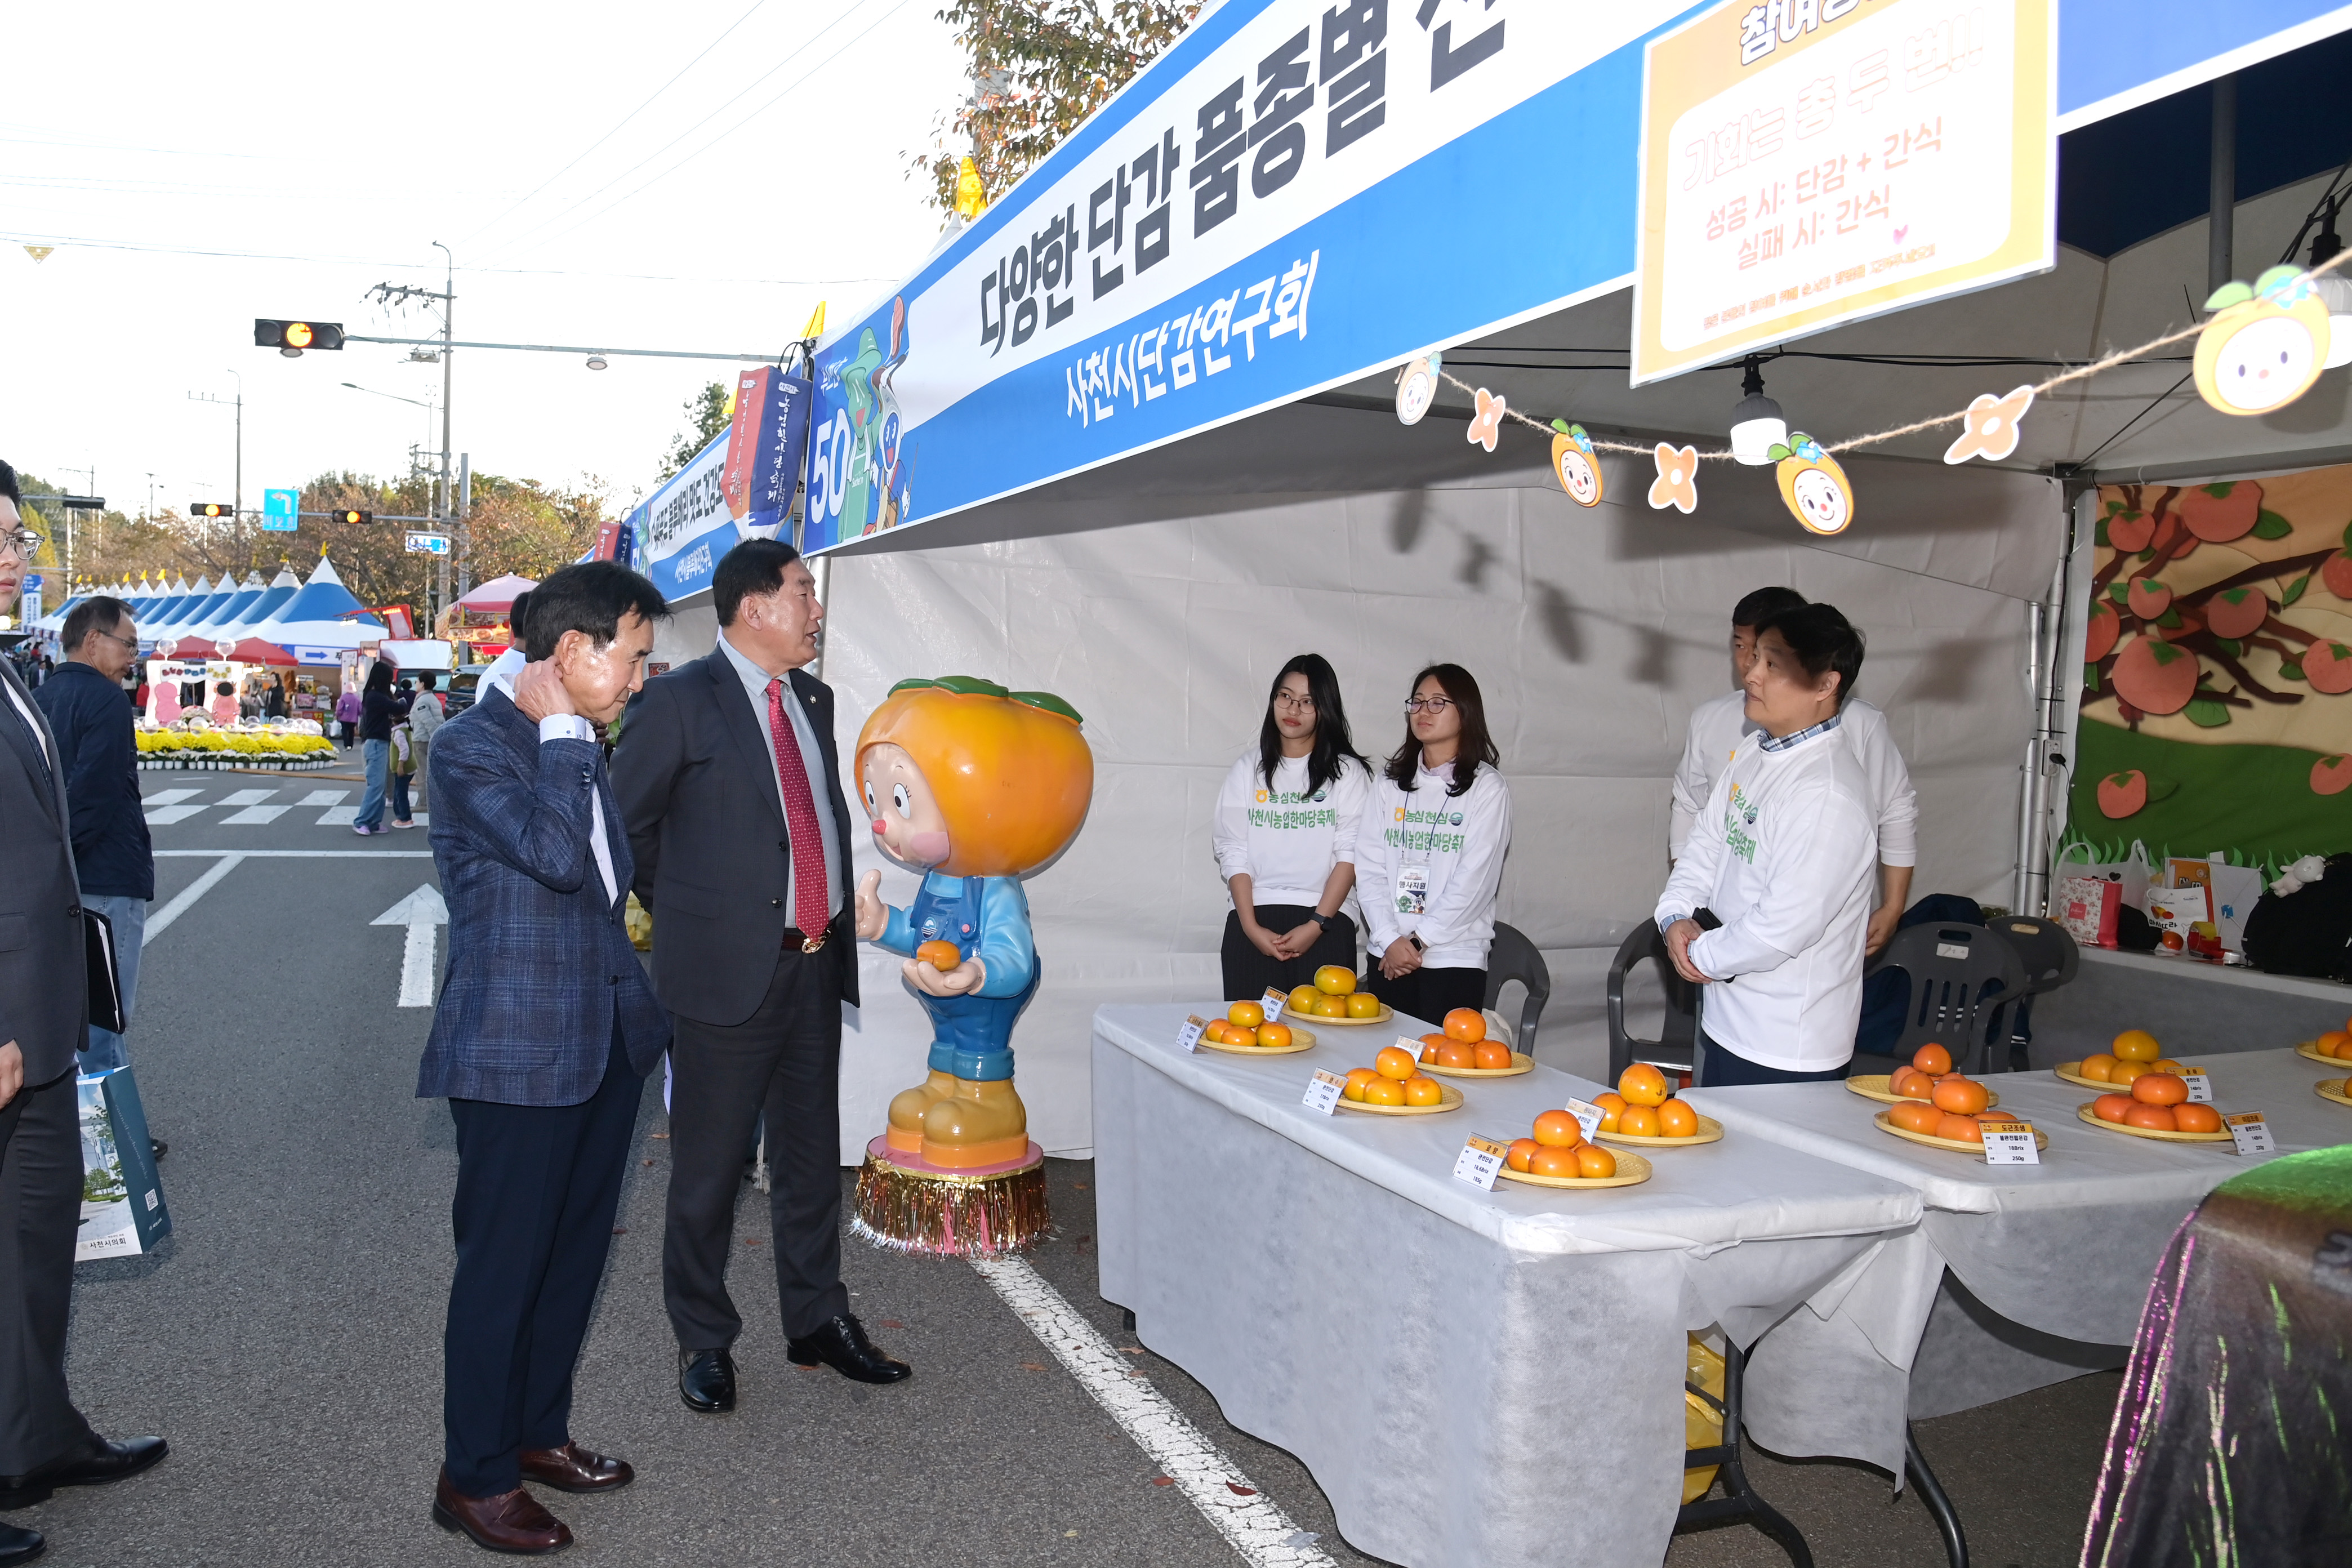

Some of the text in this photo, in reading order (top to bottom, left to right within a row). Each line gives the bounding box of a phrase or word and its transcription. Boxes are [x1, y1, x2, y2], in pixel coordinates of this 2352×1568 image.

[1683, 7, 1984, 191] 기회는 총 두 번!!
[980, 203, 1080, 359] 다양한
[1088, 126, 1181, 301] 단감
[1189, 0, 1388, 239] 품종별
[1706, 185, 1747, 241] 성공
[1756, 182, 1787, 217] 시:
[1796, 154, 1848, 205] 단감
[1883, 116, 1943, 170] 간식
[1738, 185, 1891, 271] 실패 시: 간식
[1066, 248, 1320, 429] 사천시단감연구회
[811, 408, 851, 524] 50
[264, 514, 295, 528] 비보호
[1248, 808, 1335, 829] 사천시농업한마당축제
[1405, 810, 1448, 825] 농심천심
[1399, 881, 1426, 889] 행사지원
[1474, 1164, 1489, 1174] 18.6Brix
[1478, 1154, 1493, 1164] 완전단감
[90, 1237, 127, 1249] 사천시의회
